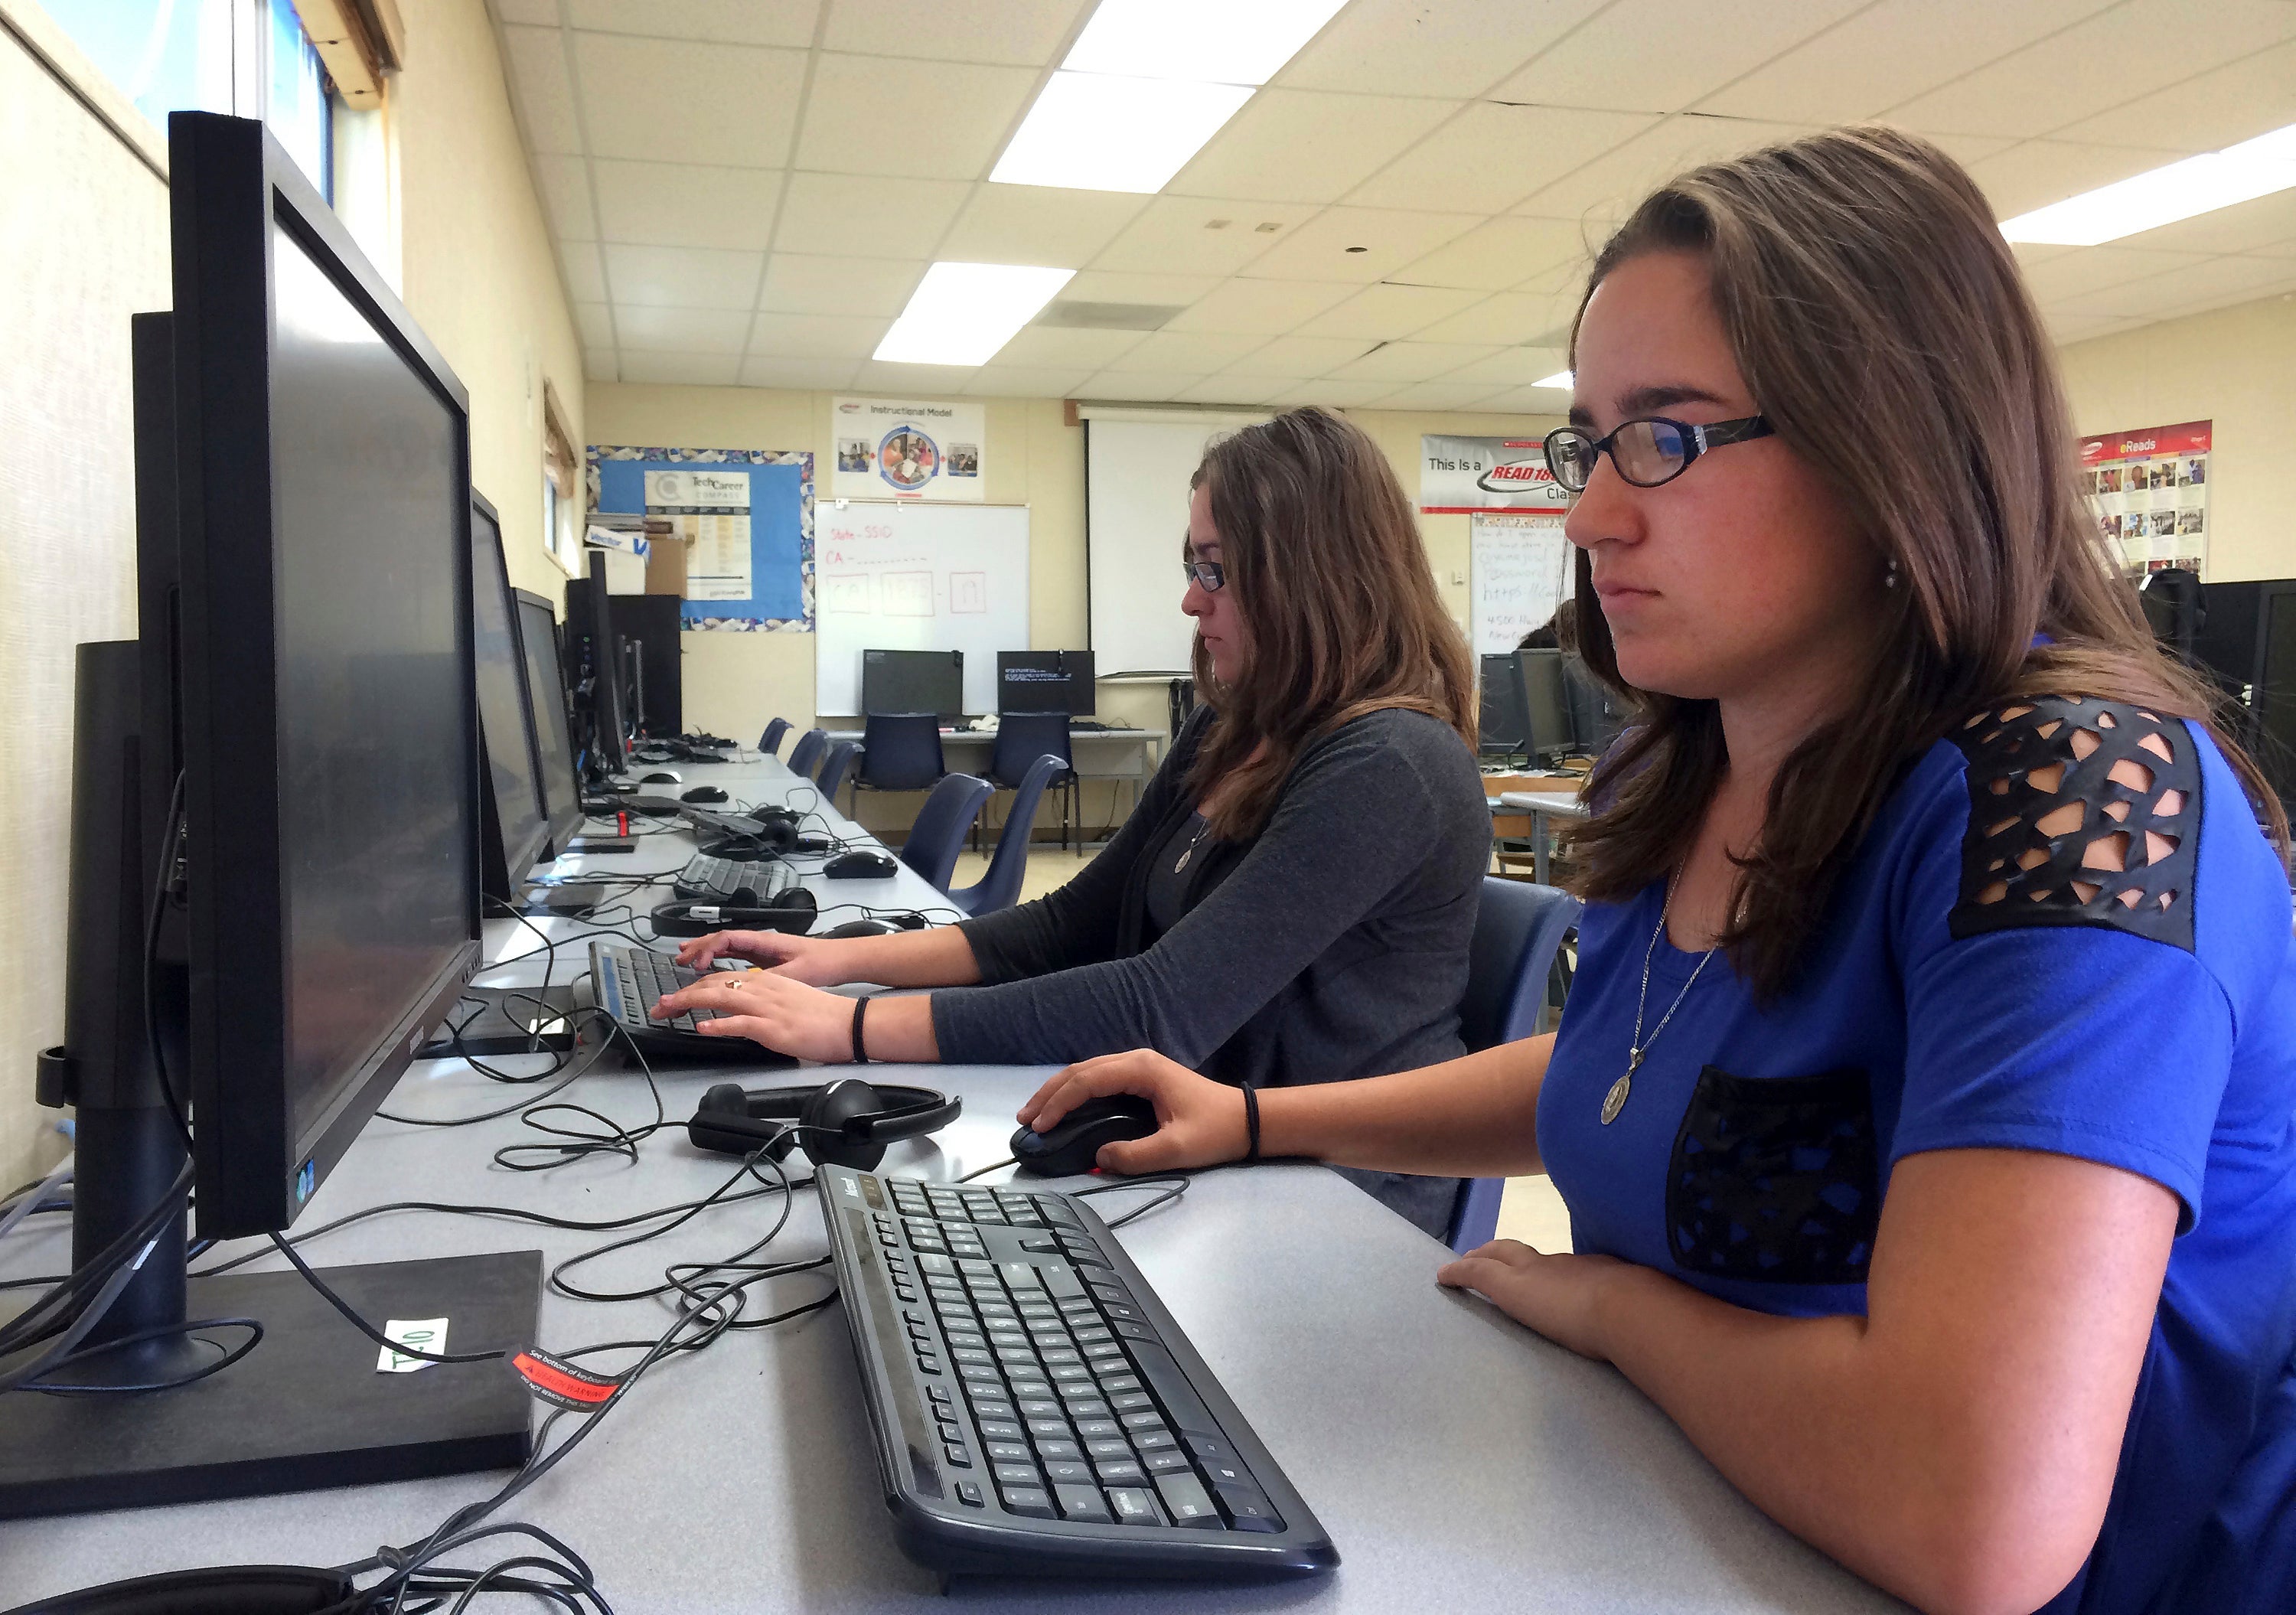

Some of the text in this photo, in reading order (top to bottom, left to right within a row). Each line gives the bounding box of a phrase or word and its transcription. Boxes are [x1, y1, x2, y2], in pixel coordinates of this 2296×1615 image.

[870, 405, 926, 416] Instructional
[927, 409, 953, 417] Model
[1428, 458, 1482, 471] This Is a
[1492, 466, 1557, 481] READ 18
[1547, 488, 1571, 500] Cla
[825, 550, 844, 565] CA
[529, 1349, 542, 1360] See
[542, 1356, 568, 1372] bottom
[568, 1366, 577, 1375] of
[520, 1375, 529, 1384] DO
[529, 1382, 542, 1392] NOT
[541, 1388, 565, 1402] REMOVE
[535, 1370, 565, 1388] HEALTH
[566, 1384, 605, 1398] WARNING
